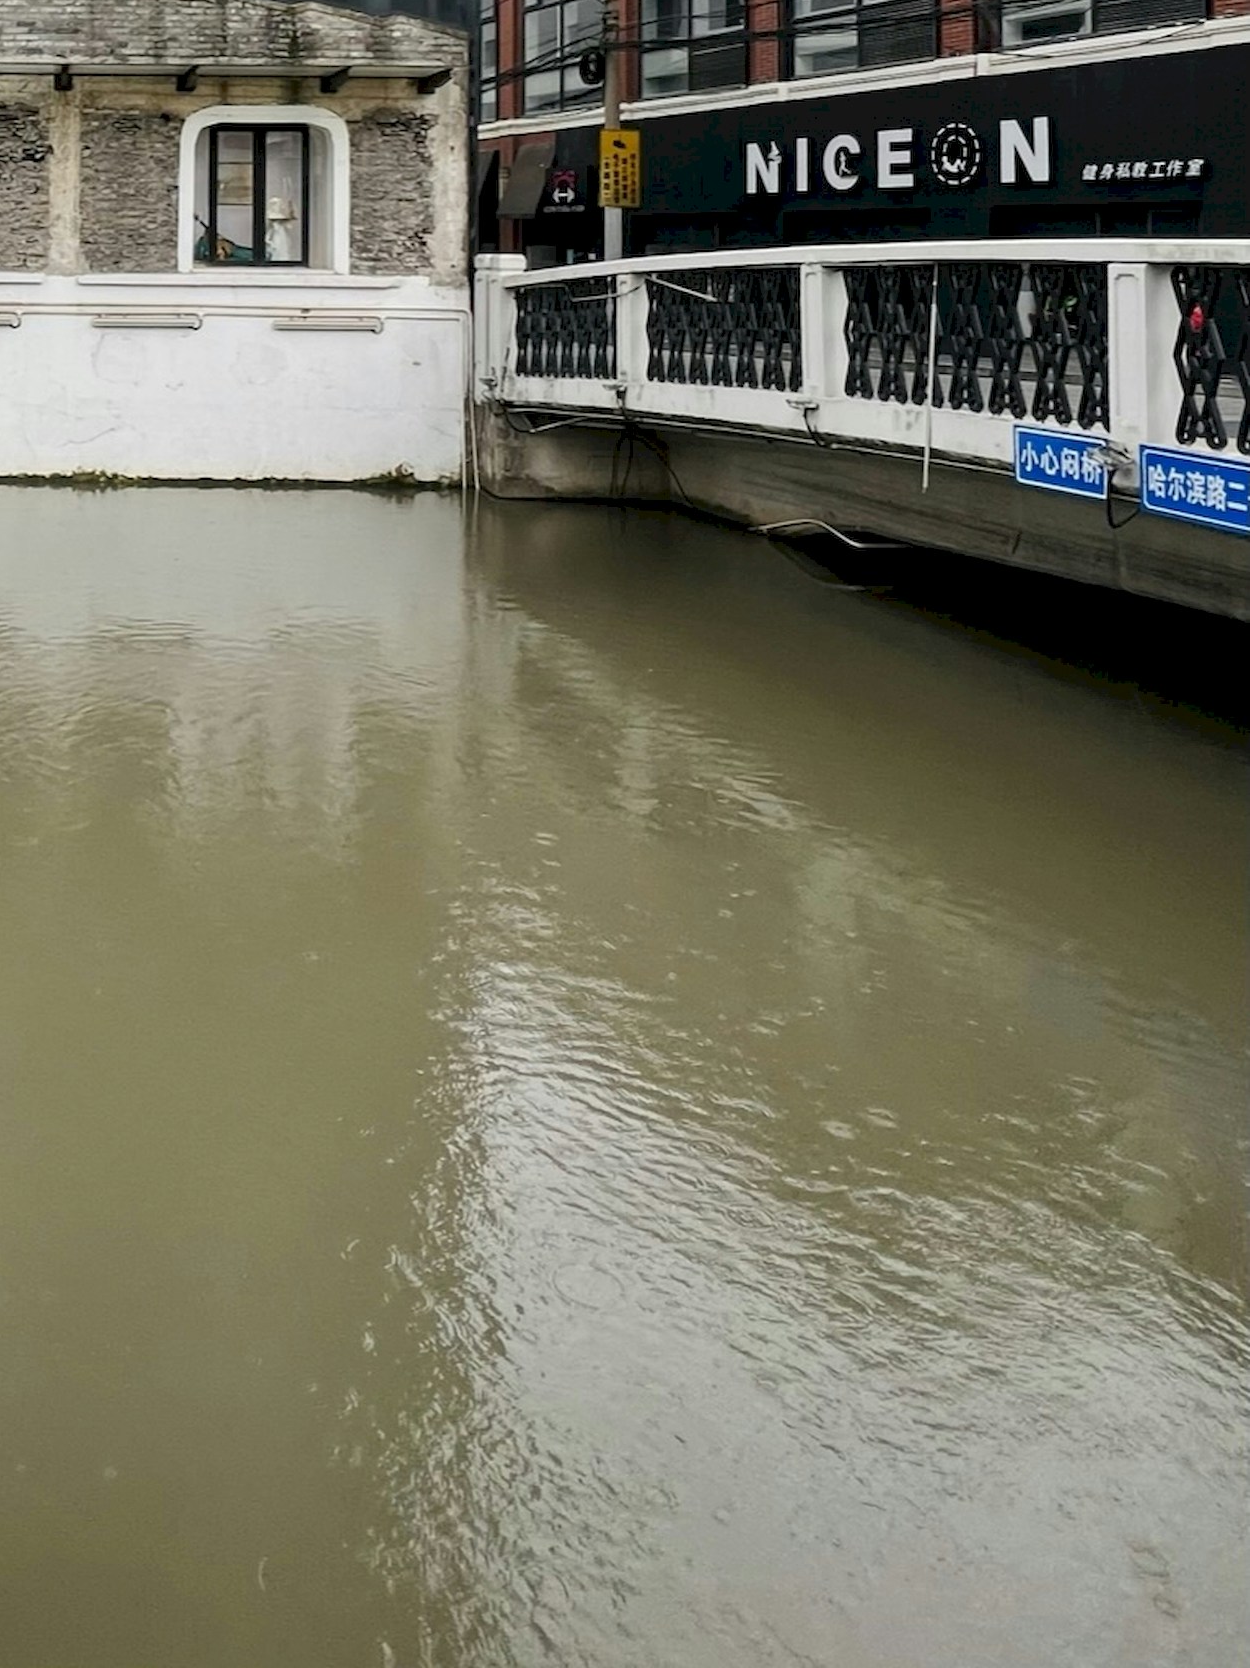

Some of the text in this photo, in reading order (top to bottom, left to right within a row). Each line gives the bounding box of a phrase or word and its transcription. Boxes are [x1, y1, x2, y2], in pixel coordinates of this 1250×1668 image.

[1148, 464, 1250, 512] 哈尔滨路二
